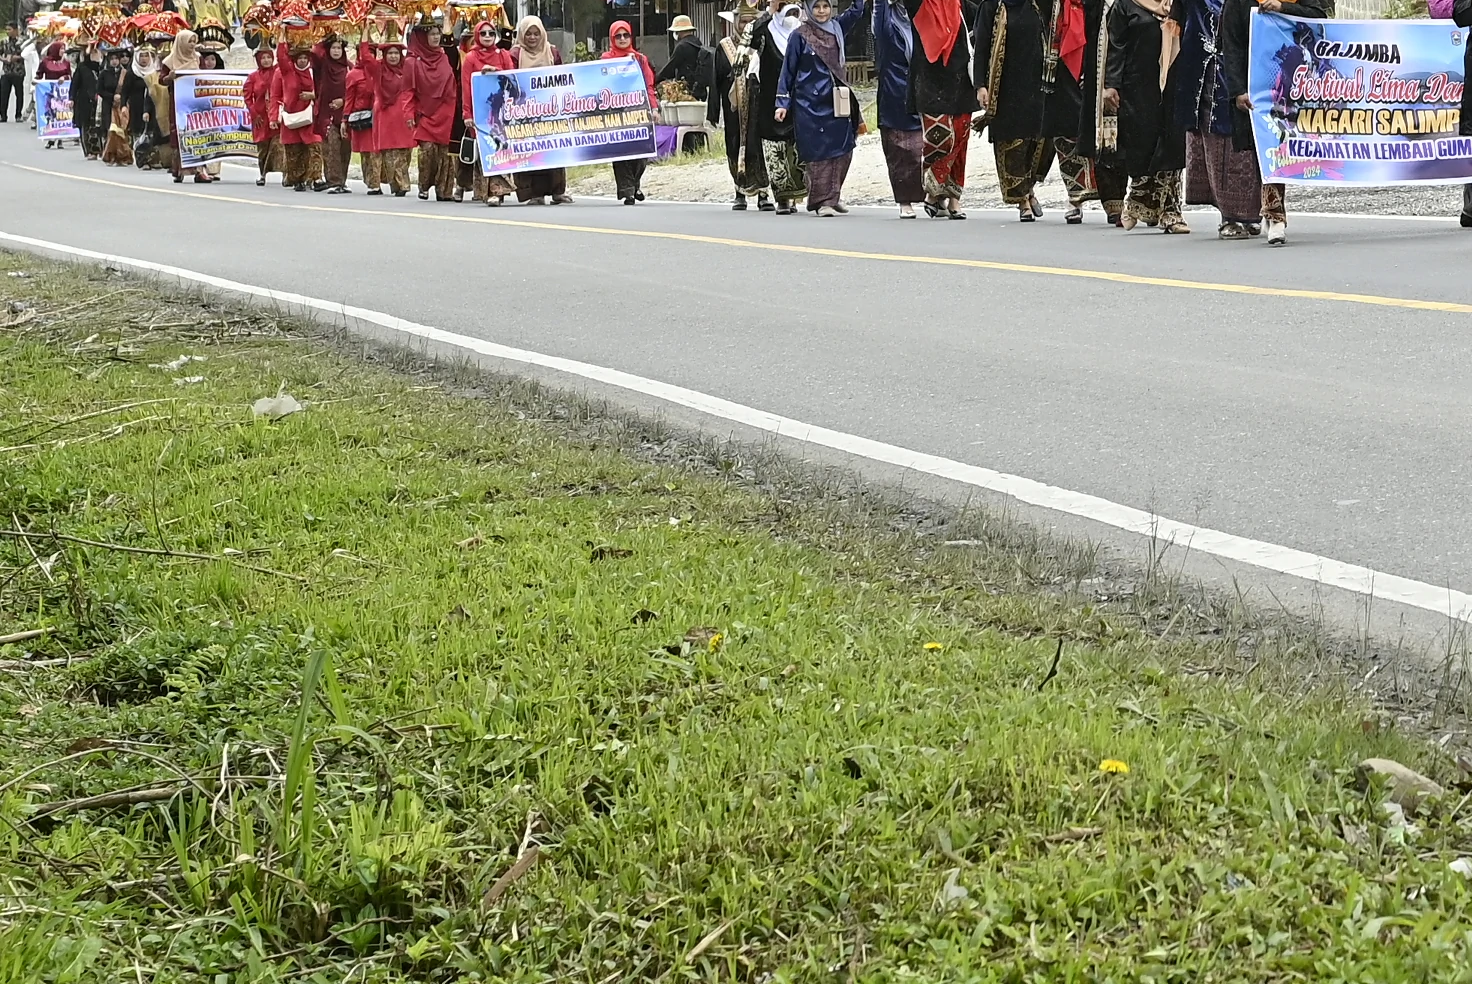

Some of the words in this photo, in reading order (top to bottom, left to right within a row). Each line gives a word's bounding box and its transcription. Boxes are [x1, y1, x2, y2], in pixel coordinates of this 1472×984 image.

[1316, 40, 1401, 64] BAJAMBA
[531, 73, 575, 90] BAJAMBA
[1290, 66, 1364, 102] Festival
[1367, 68, 1420, 103] Lima
[504, 95, 559, 120] Festival
[561, 91, 596, 114] Lima
[599, 87, 645, 110] Danau
[186, 109, 238, 131] ARAKAN
[570, 114, 604, 132] TANJUNG
[605, 112, 622, 128] NAN
[622, 108, 649, 126] AMPEK
[1297, 109, 1373, 134] NAGARI
[1377, 108, 1461, 134] SALIMP
[185, 134, 213, 146] Nagari
[513, 137, 573, 154] KECAMATAN
[574, 132, 607, 147] DANAU
[609, 128, 648, 143] KEMBAR
[1288, 138, 1371, 160] KECAMATAN
[1374, 139, 1434, 161] LEMBAH
[1303, 164, 1321, 179] 2024
